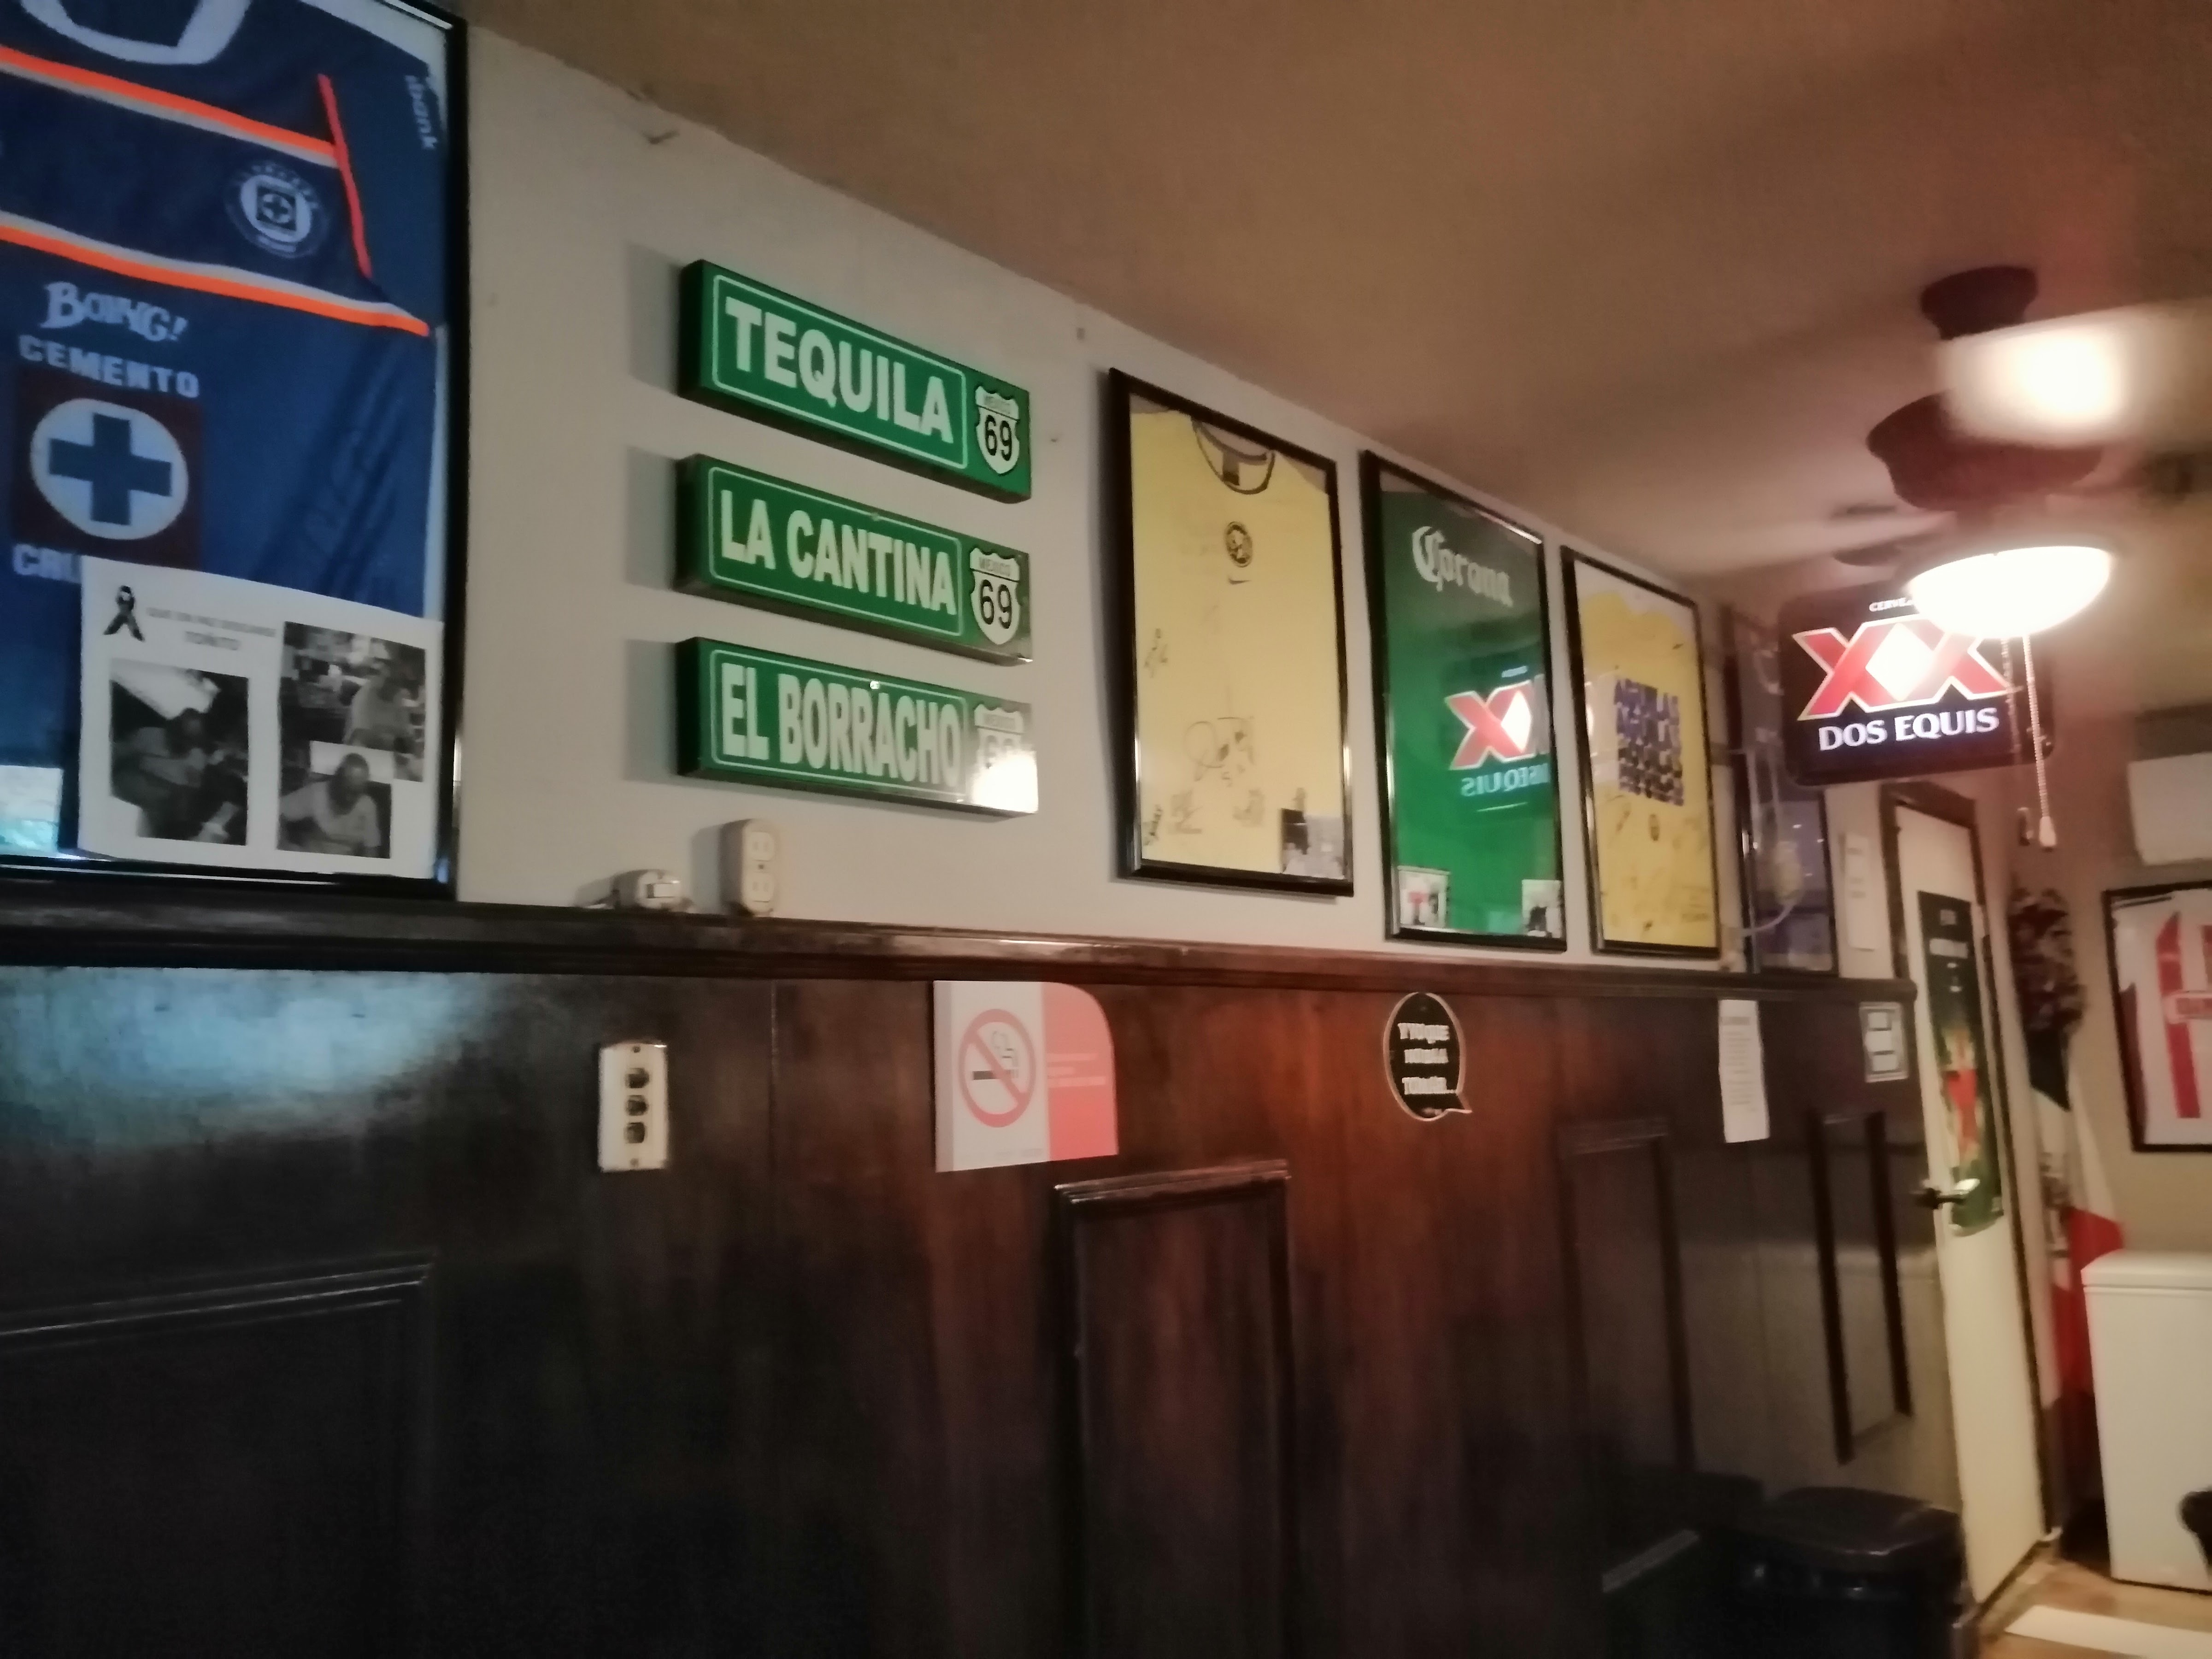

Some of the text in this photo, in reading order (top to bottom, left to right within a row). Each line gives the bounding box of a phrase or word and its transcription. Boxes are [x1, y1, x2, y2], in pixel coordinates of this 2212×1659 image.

[19, 335, 199, 398] CEMENTO
[724, 296, 953, 443] TEQUILA
[984, 415, 1012, 462] 69
[721, 489, 957, 615] LA CANTINA
[980, 579, 1012, 629] 69
[721, 662, 962, 787] EL BORRACHO
[1818, 707, 2000, 751] DOS EQUIS
